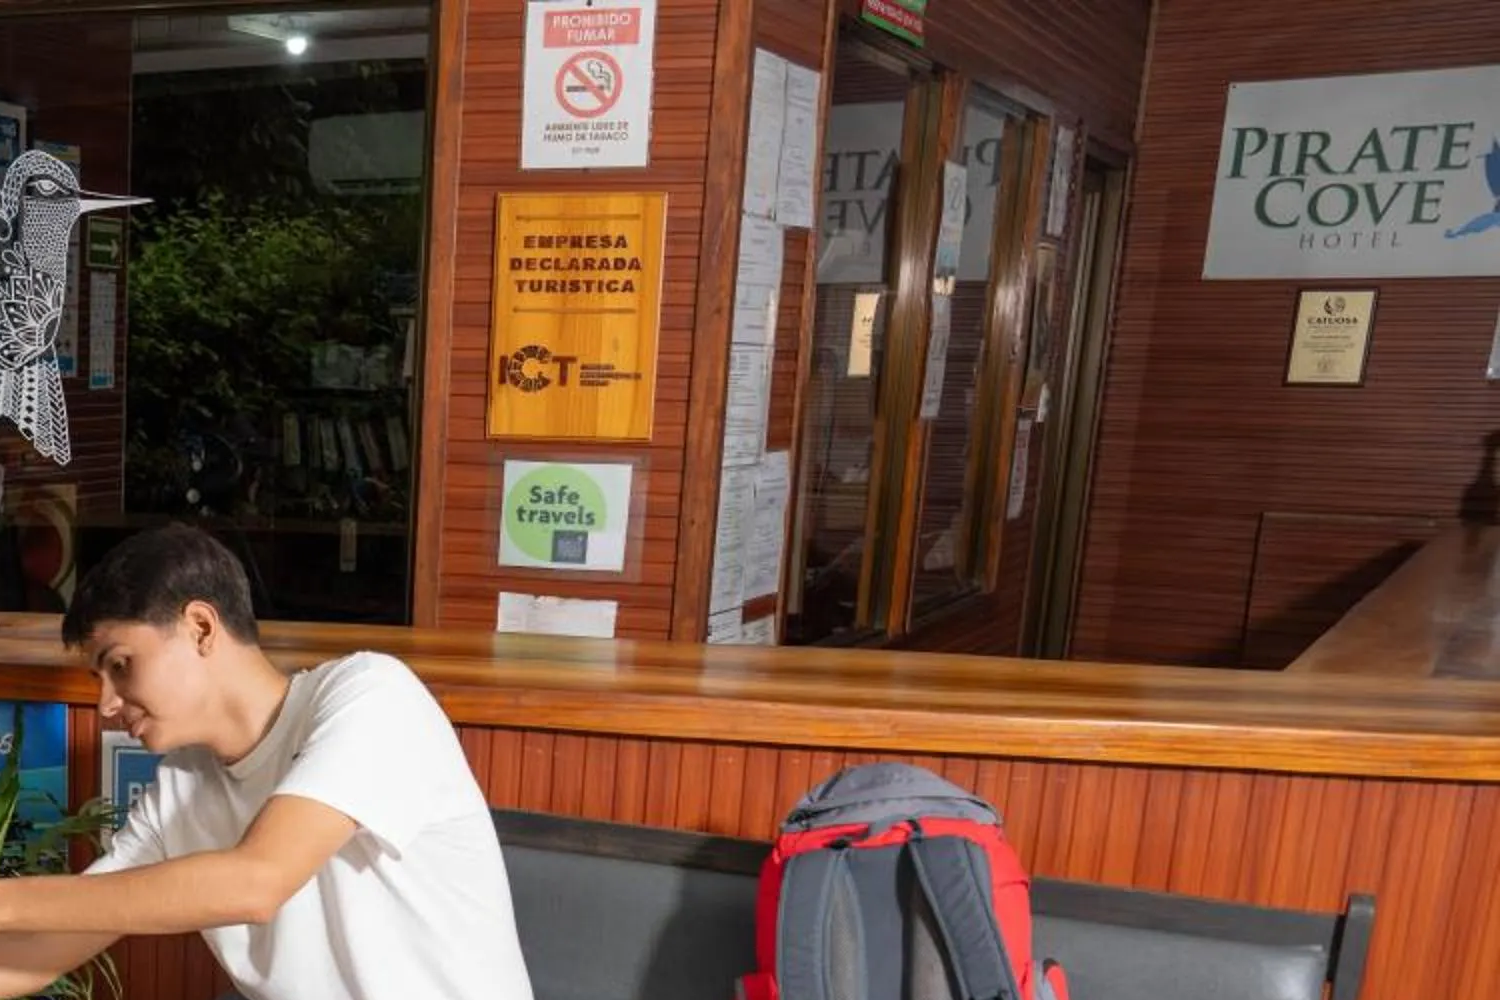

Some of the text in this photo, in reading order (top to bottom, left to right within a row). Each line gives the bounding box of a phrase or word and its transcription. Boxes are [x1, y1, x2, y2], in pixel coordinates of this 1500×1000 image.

[552, 13, 631, 28] PROHIBIDO
[566, 29, 617, 42] FUMAR
[575, 132, 586, 142] DE
[588, 131, 630, 142] TABACO
[1225, 122, 1476, 180] PIRATE
[1254, 179, 1446, 229] COVE
[522, 234, 629, 249] EMPRESA
[1298, 231, 1405, 251] HOTEL
[509, 256, 643, 272] DECLARADA
[514, 279, 636, 294] TURISTICA
[528, 484, 581, 505] Safe
[515, 505, 597, 527] travels
